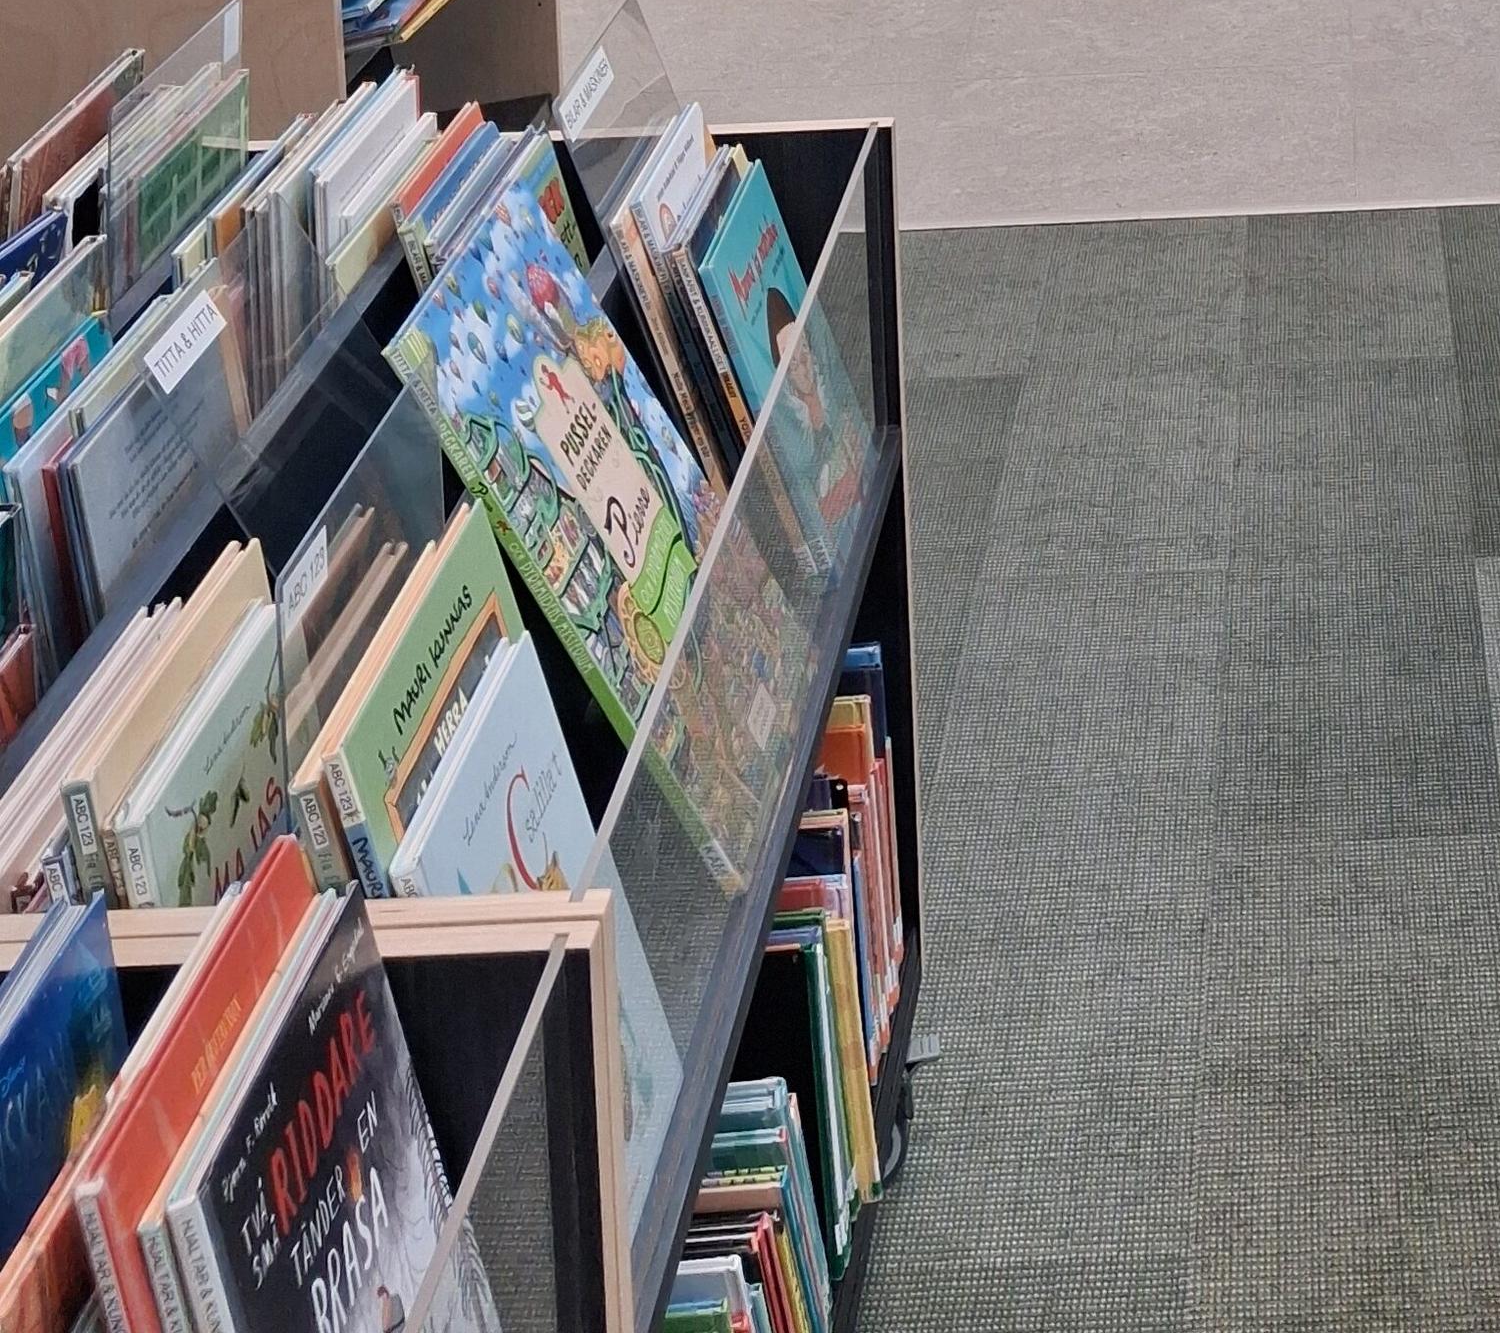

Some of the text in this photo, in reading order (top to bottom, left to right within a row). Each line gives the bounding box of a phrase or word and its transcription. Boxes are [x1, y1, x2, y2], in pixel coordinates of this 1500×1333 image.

[154, 304, 218, 378] TITTA & HITTA
[560, 401, 598, 466] PUSSEL-
[576, 423, 612, 491] DECKAREN
[393, 585, 473, 735] MAURI KUNNAS
[73, 798, 88, 823] ABC
[80, 827, 94, 846] 123
[303, 797, 319, 823] ABC
[312, 825, 327, 846] 123
[329, 763, 385, 898] ABC 123 MAUR
[47, 868, 63, 892] ABC
[105, 840, 120, 864] ABC
[128, 848, 148, 896] ABC 123
[269, 989, 377, 1237] RIDDARE
[289, 1090, 380, 1289] TÄNDER EN
[311, 1166, 390, 1333] BRASA
